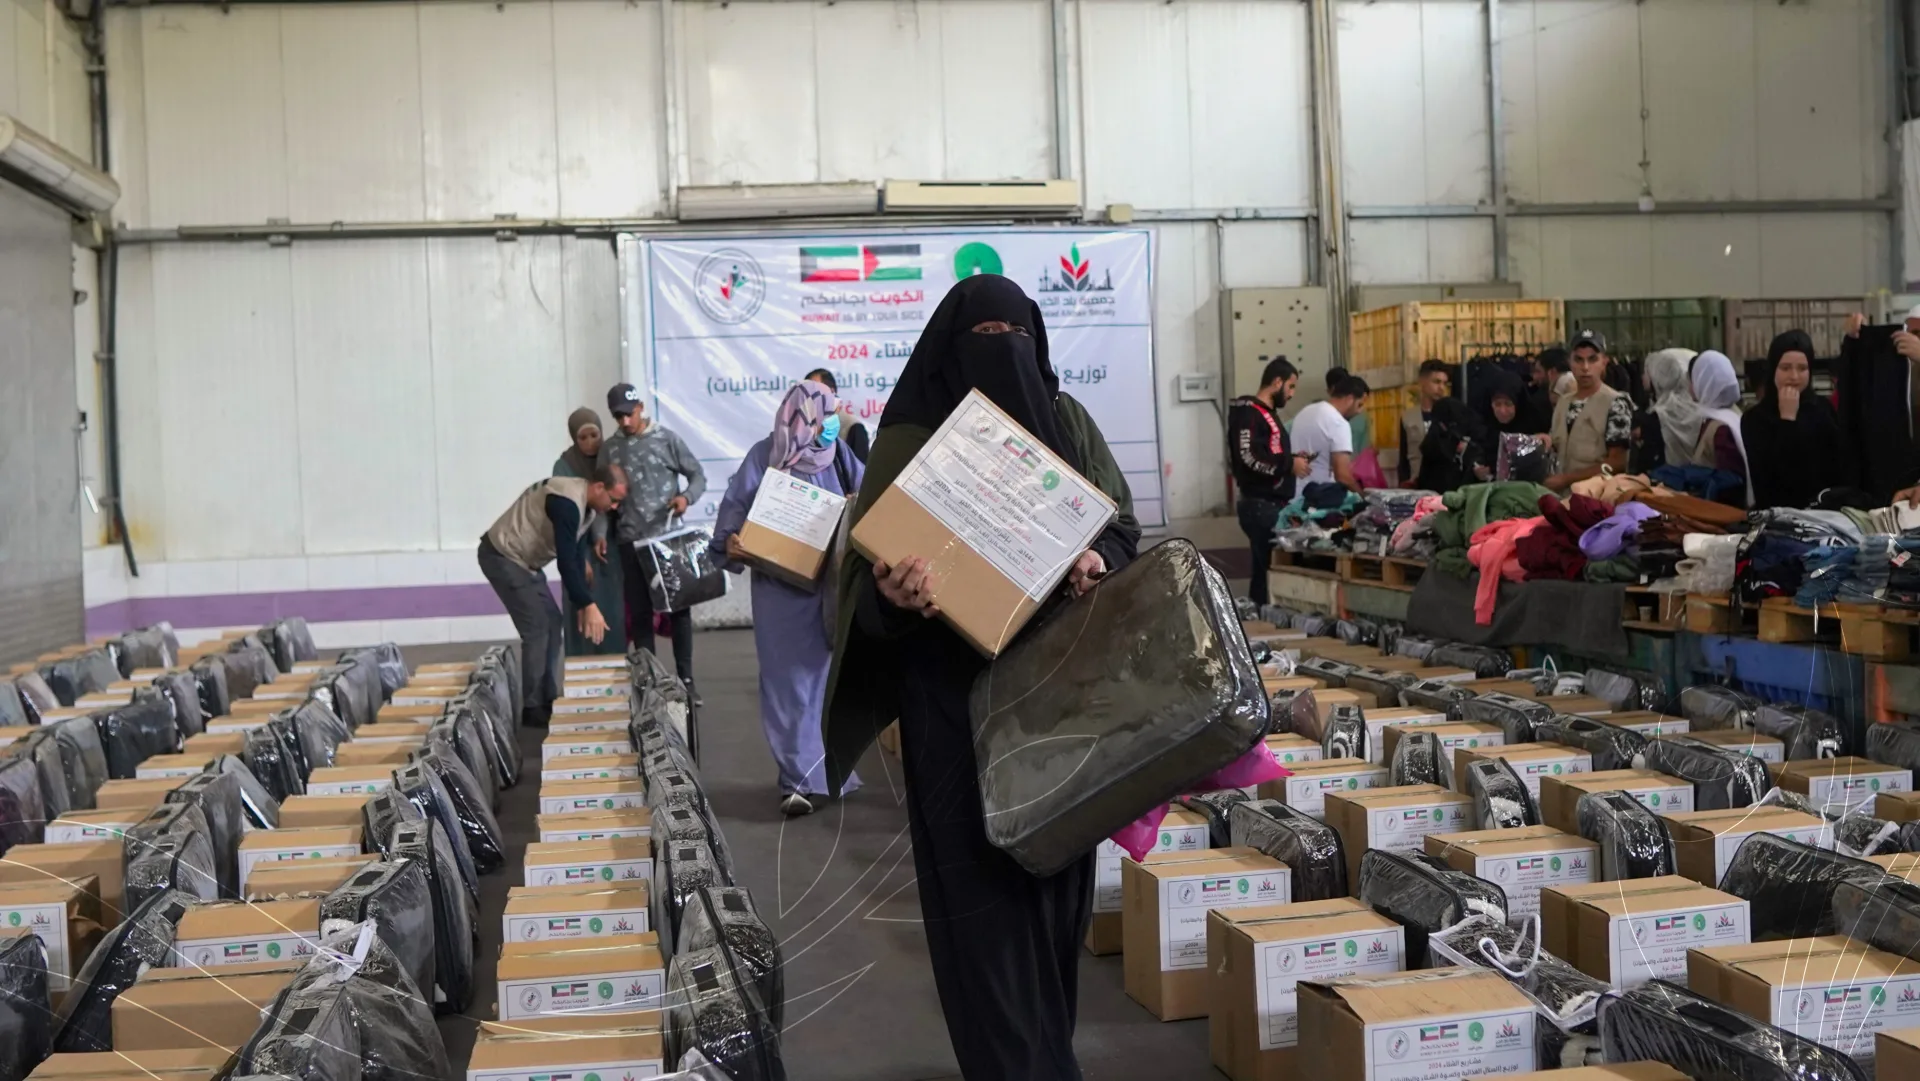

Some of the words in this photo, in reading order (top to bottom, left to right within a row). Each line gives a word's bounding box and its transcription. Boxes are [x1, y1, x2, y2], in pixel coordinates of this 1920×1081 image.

[801, 292, 866, 308] بجانبكم
[869, 290, 924, 305] الكويت
[801, 313, 839, 323] KUWAIT
[870, 310, 898, 321] OUR
[901, 310, 924, 320] SIDE
[828, 344, 869, 359] 2024
[1064, 365, 1107, 384] توزيع
